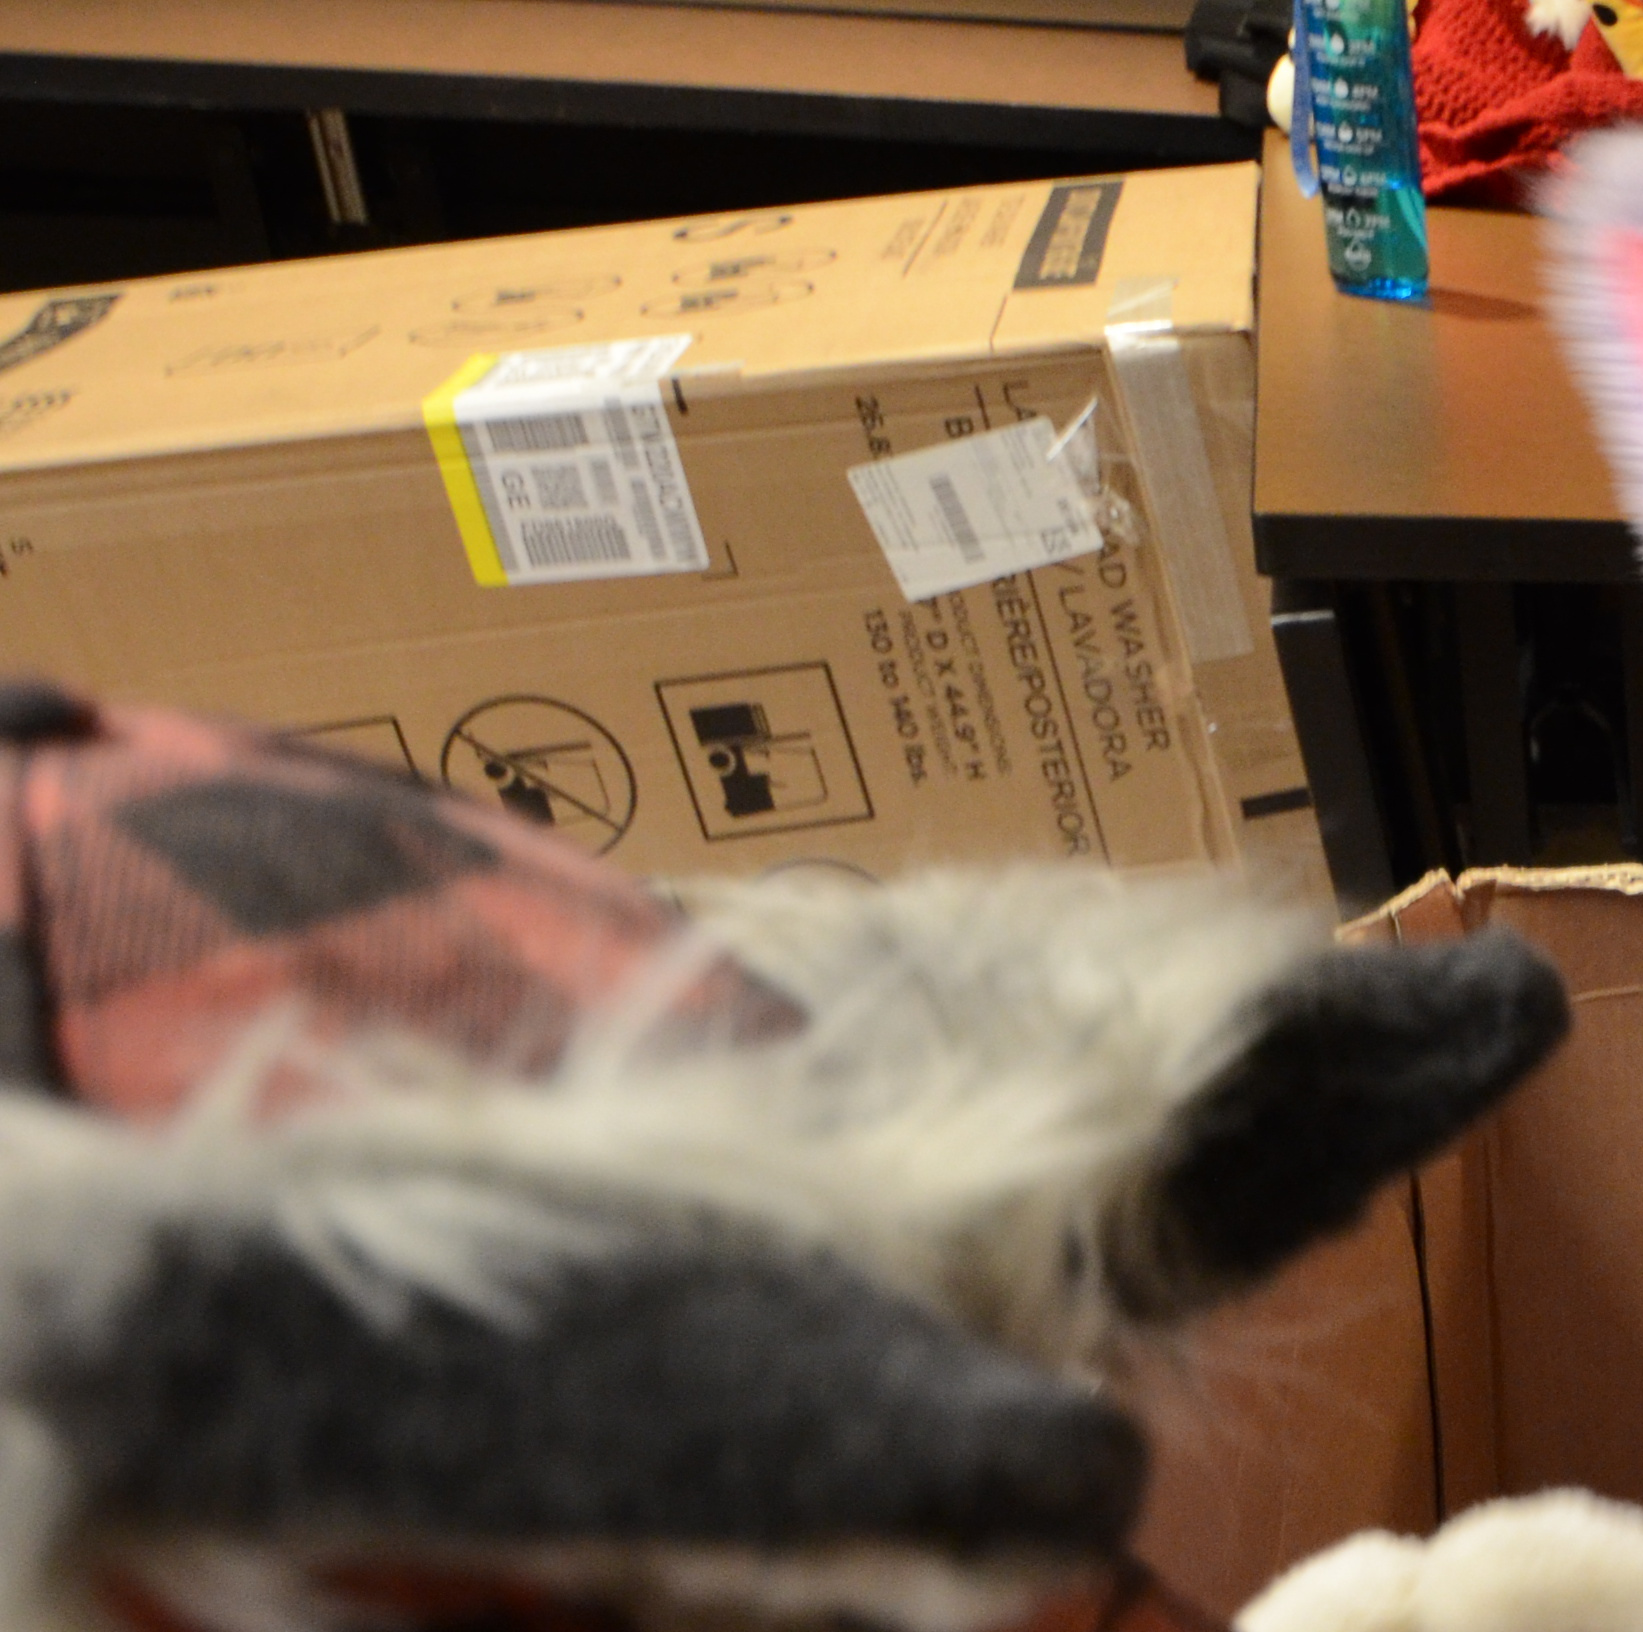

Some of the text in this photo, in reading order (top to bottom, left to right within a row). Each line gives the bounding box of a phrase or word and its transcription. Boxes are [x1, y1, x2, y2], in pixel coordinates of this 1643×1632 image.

[502, 470, 531, 509] GE
[865, 608, 893, 655] 130
[892, 695, 918, 739] 140
[1059, 585, 1132, 782] LAVADORA
[1110, 599, 1170, 751] WASHER
